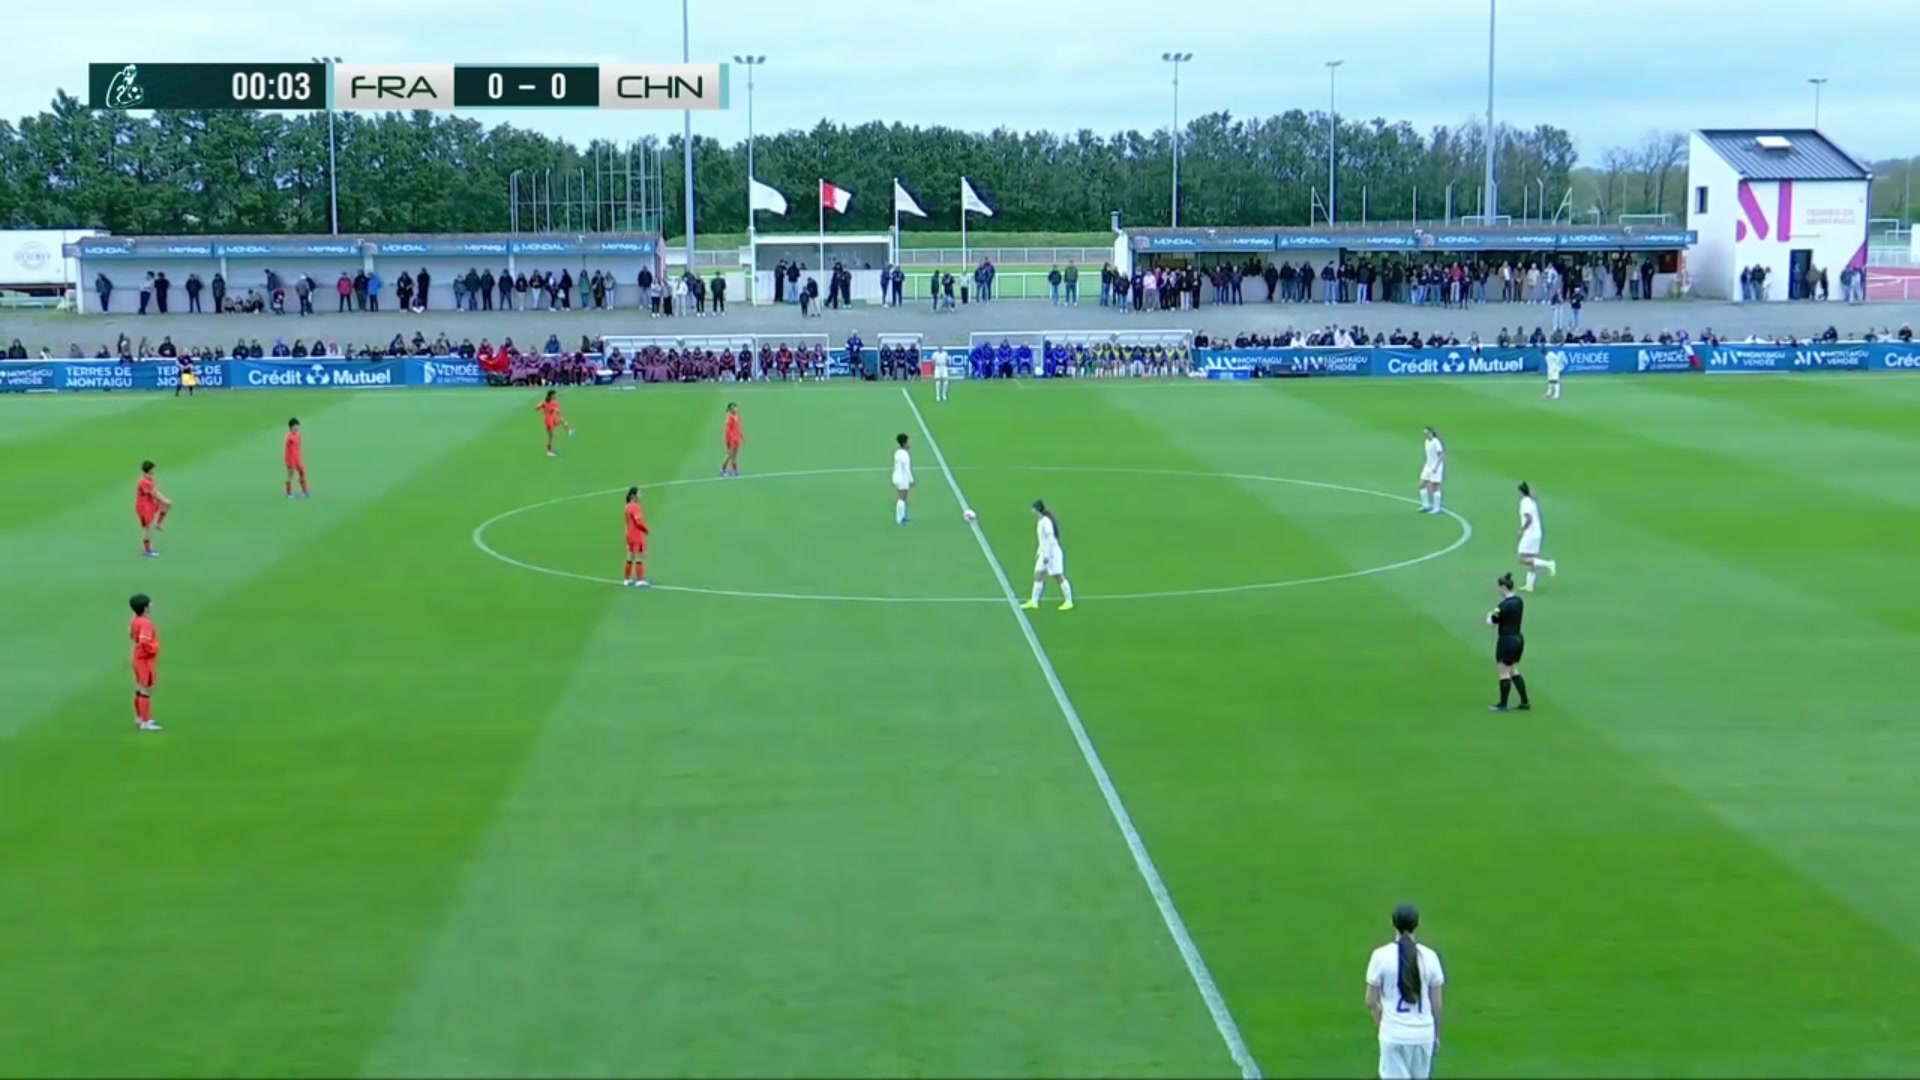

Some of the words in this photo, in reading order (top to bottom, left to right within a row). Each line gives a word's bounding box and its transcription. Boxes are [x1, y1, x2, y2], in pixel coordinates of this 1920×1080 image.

[1568, 350, 1610, 364] VENDÉE
[66, 366, 112, 377] TERRES
[115, 366, 132, 377] DE
[205, 364, 222, 375] DE
[436, 362, 480, 376] VENDÉE
[1387, 356, 1439, 374] Crédit
[1468, 356, 1524, 374] Mutuel
[65, 377, 133, 387] MONTAIGU
[248, 368, 303, 386] Crédit
[333, 367, 391, 385] Mutuel
